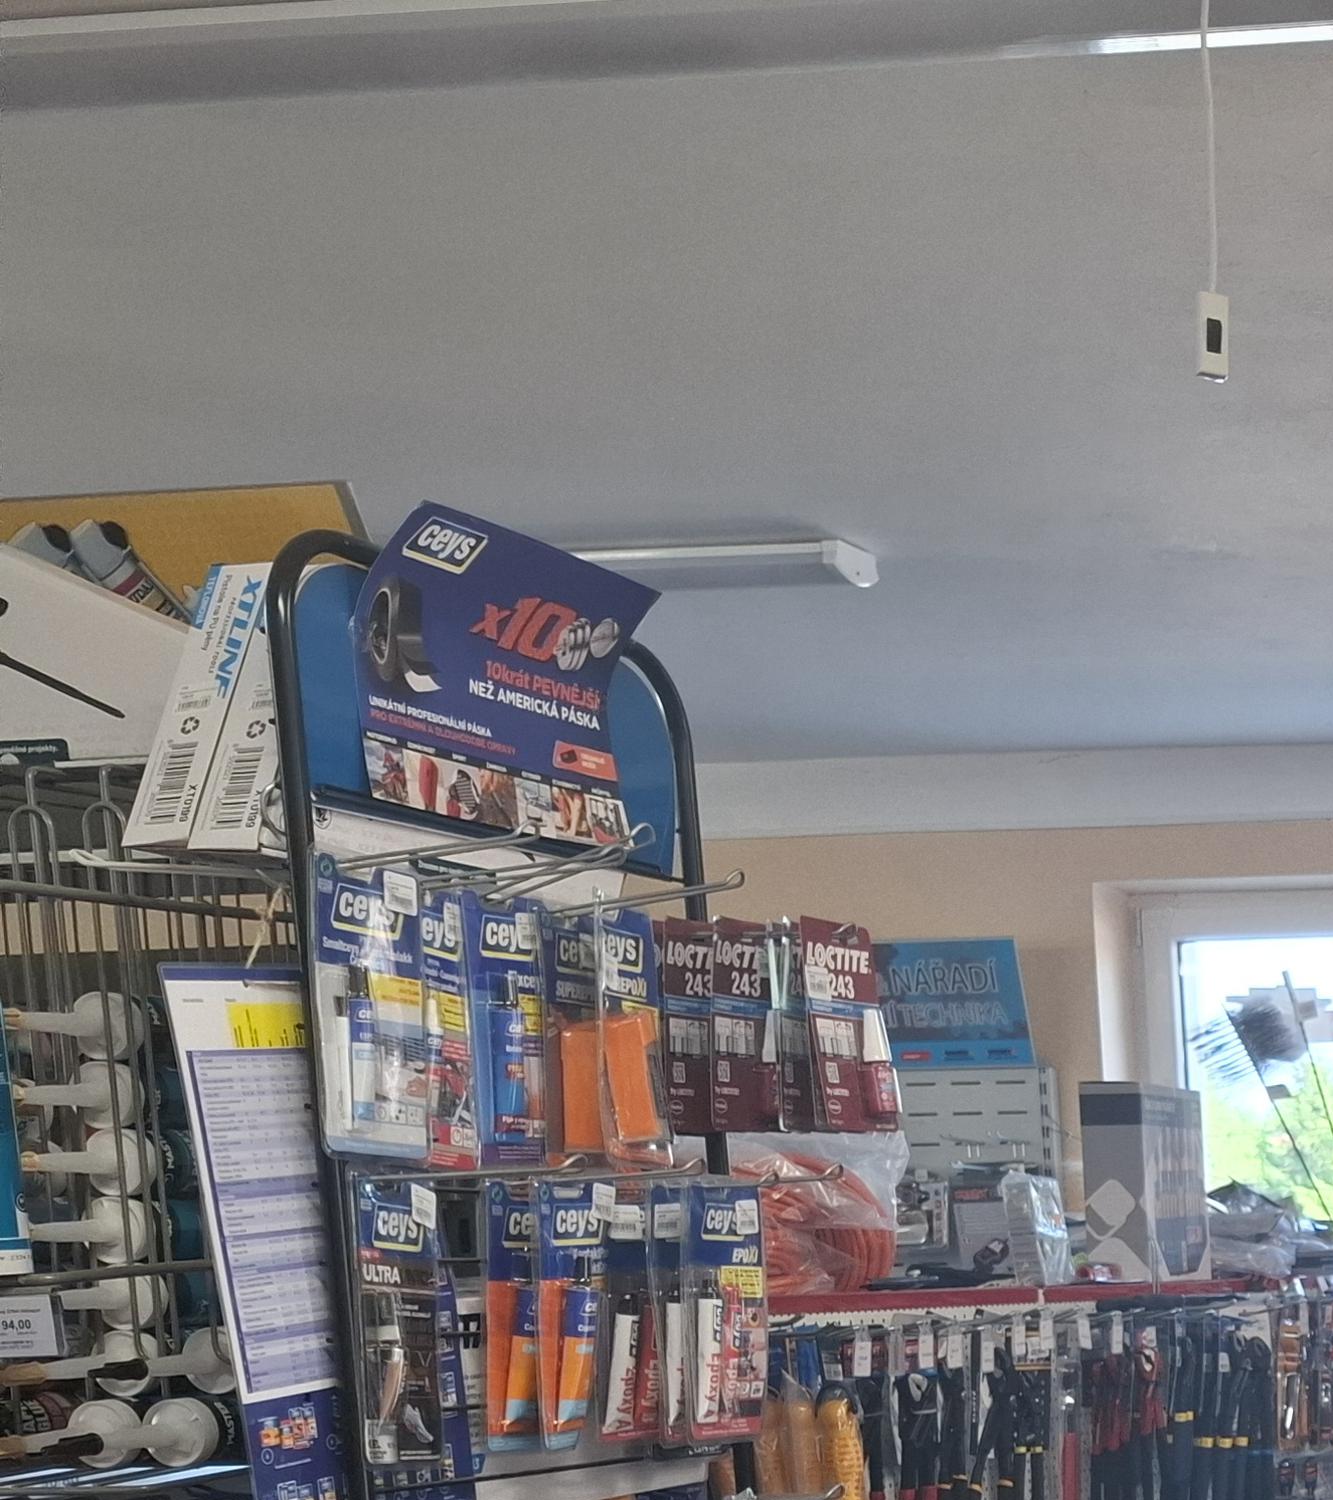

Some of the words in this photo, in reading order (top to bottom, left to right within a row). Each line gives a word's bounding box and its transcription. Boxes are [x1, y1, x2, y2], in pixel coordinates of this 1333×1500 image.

[417, 524, 477, 561] ceys
[214, 575, 263, 700] XTLINE
[468, 595, 578, 663] x10
[486, 660, 531, 691] 10krát
[469, 678, 494, 700] NEŽ
[497, 688, 558, 721] AMERICKÁ
[561, 704, 600, 731] PÁSKA
[806, 941, 870, 974] LOCTITE
[731, 973, 760, 997] 243
[890, 955, 998, 993] NÁŘADÍ
[377, 1209, 418, 1240] ceys
[556, 1209, 600, 1238] ceys
[732, 1247, 758, 1264] EPOXI
[362, 1263, 401, 1285] ULTRA
